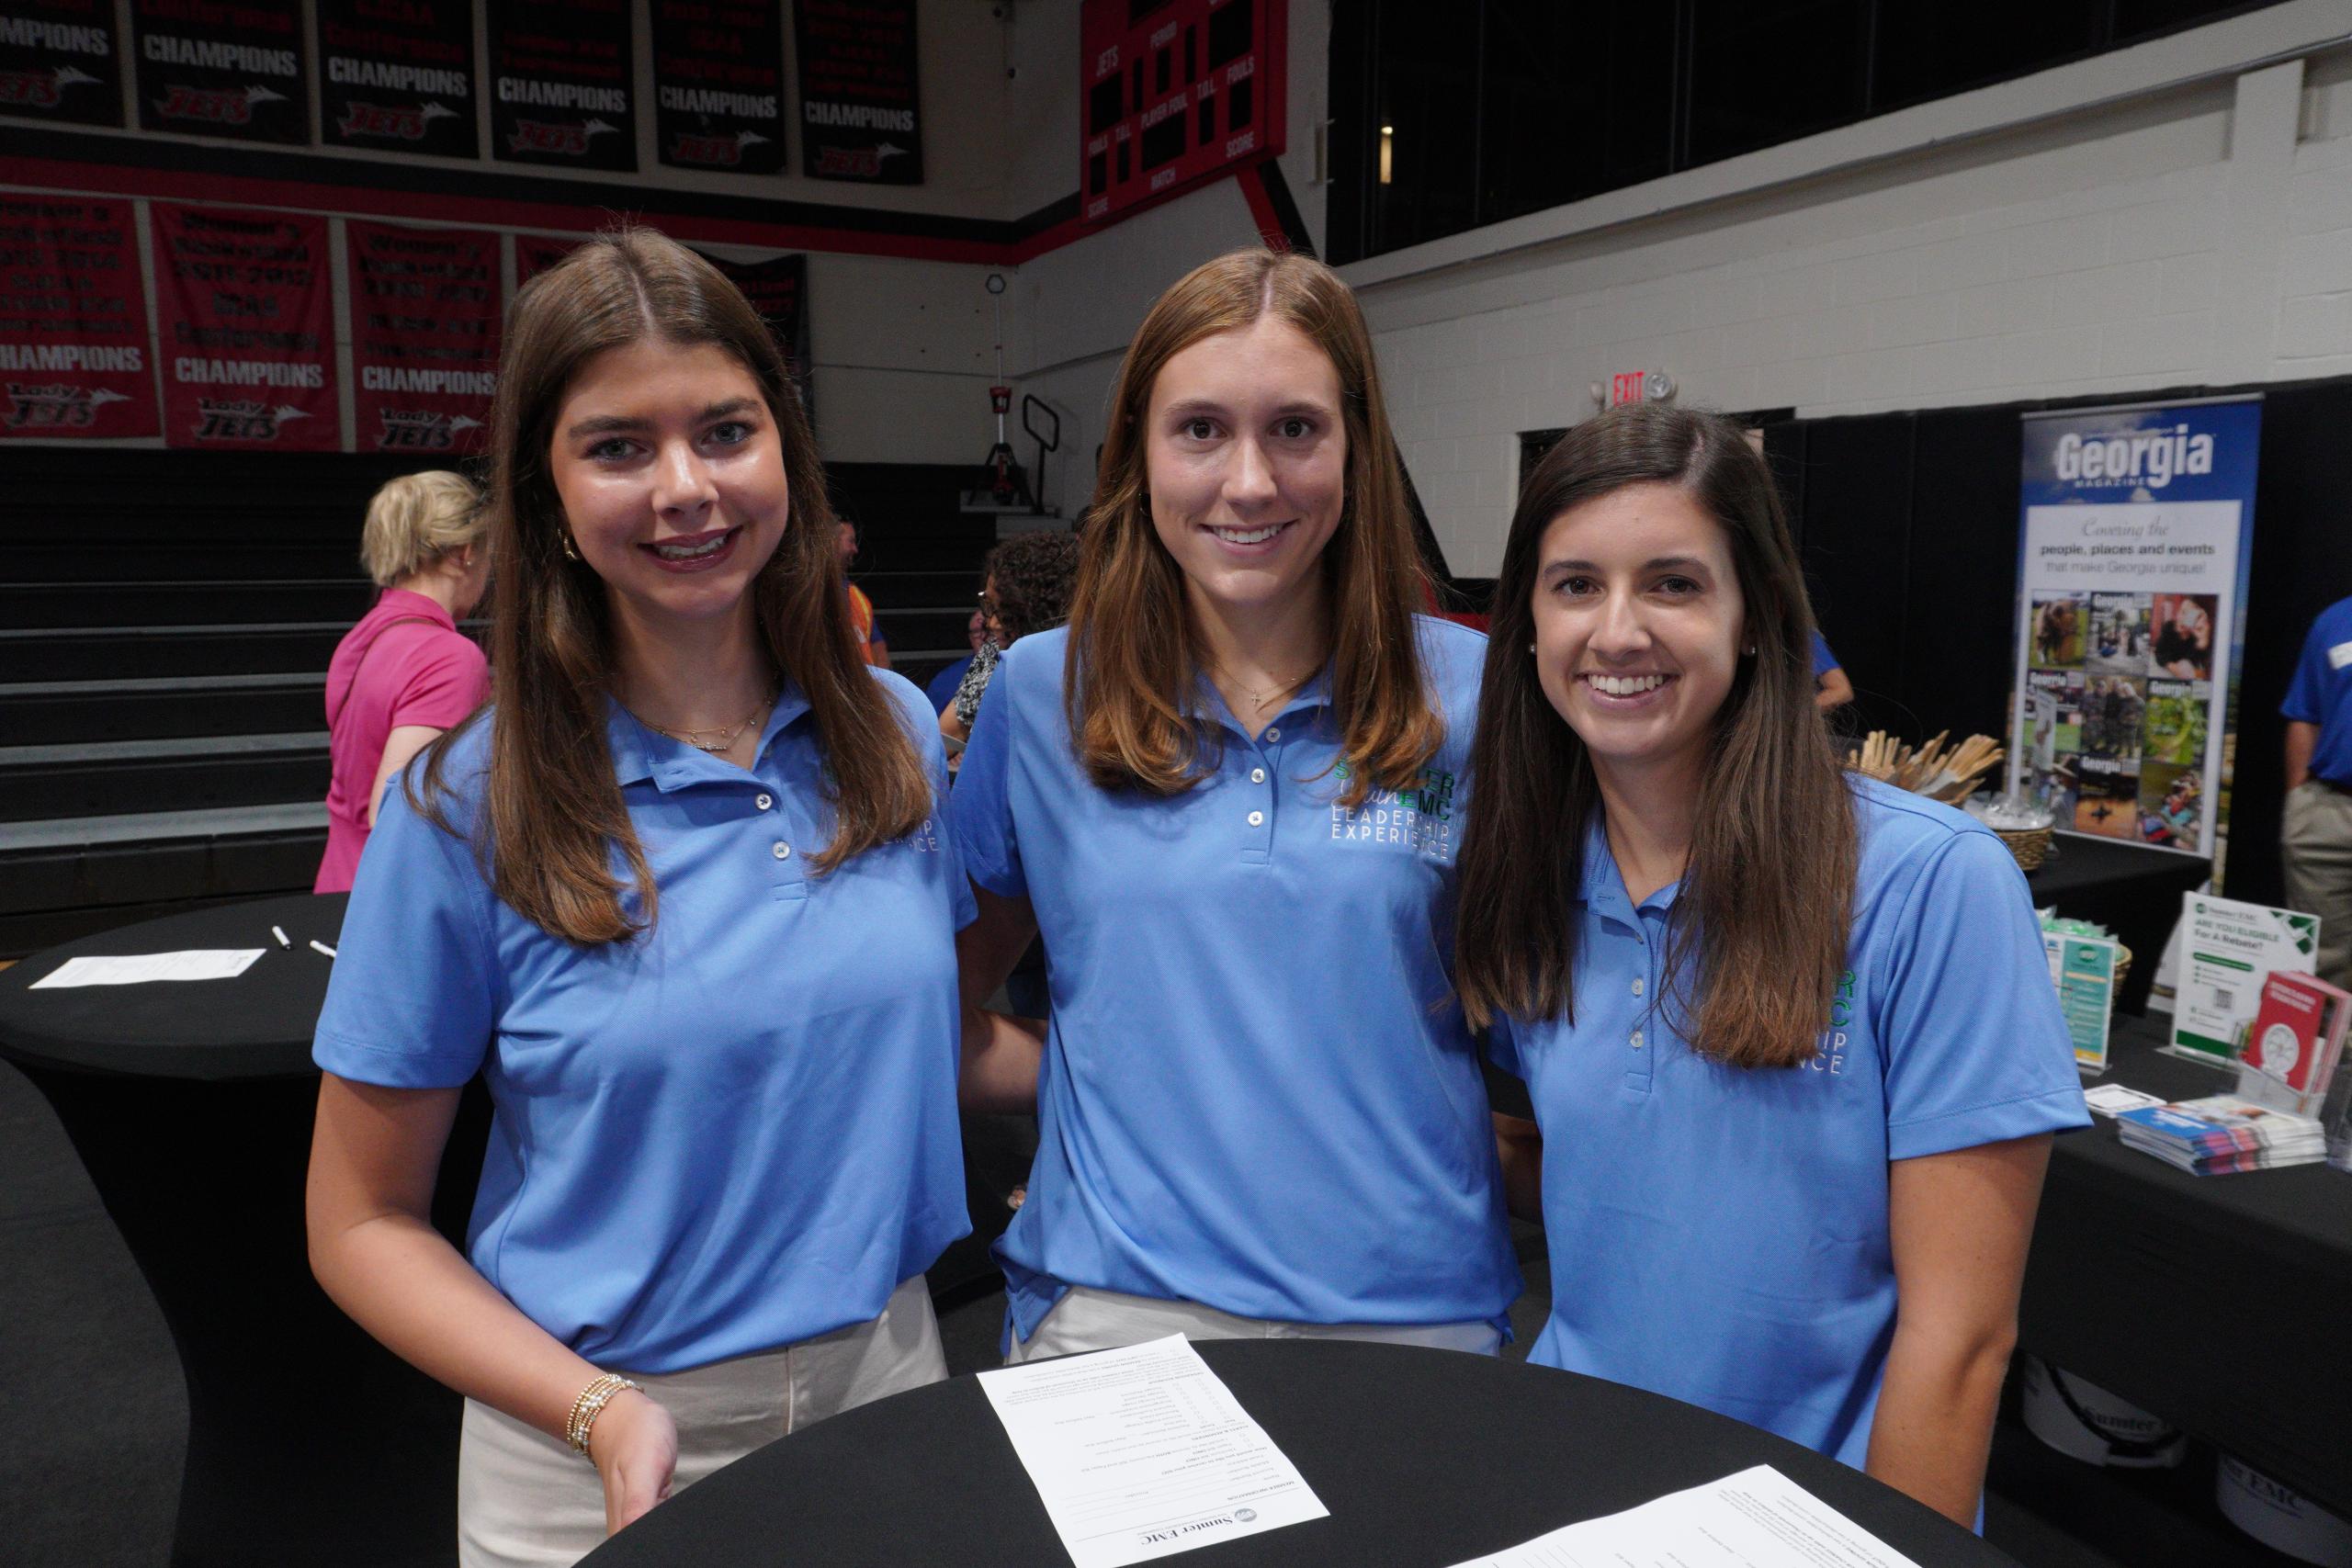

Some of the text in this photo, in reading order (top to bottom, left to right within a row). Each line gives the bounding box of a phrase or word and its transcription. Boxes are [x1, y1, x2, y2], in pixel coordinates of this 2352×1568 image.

[143, 33, 298, 77] CHAMPIONS
[328, 55, 468, 97] CHAMPIONS
[498, 76, 627, 114] CHAMPIONS
[660, 85, 777, 119] CHAMPIONS
[805, 100, 914, 132] CHAMPIONS
[175, 357, 323, 389] CHAMPIONS
[362, 366, 496, 396] CHAMPIONS
[1613, 371, 1645, 407] EXIT
[380, 409, 443, 426] Lady
[2056, 423, 2214, 489] Georgia
[2041, 543, 2215, 557] people, places and events
[2045, 561, 2067, 573] that
[2072, 561, 2104, 573] make
[2107, 560, 2156, 576] Georgia
[1140, 1529, 1179, 1546] EMC
[1182, 1517, 1233, 1534] Sumter
